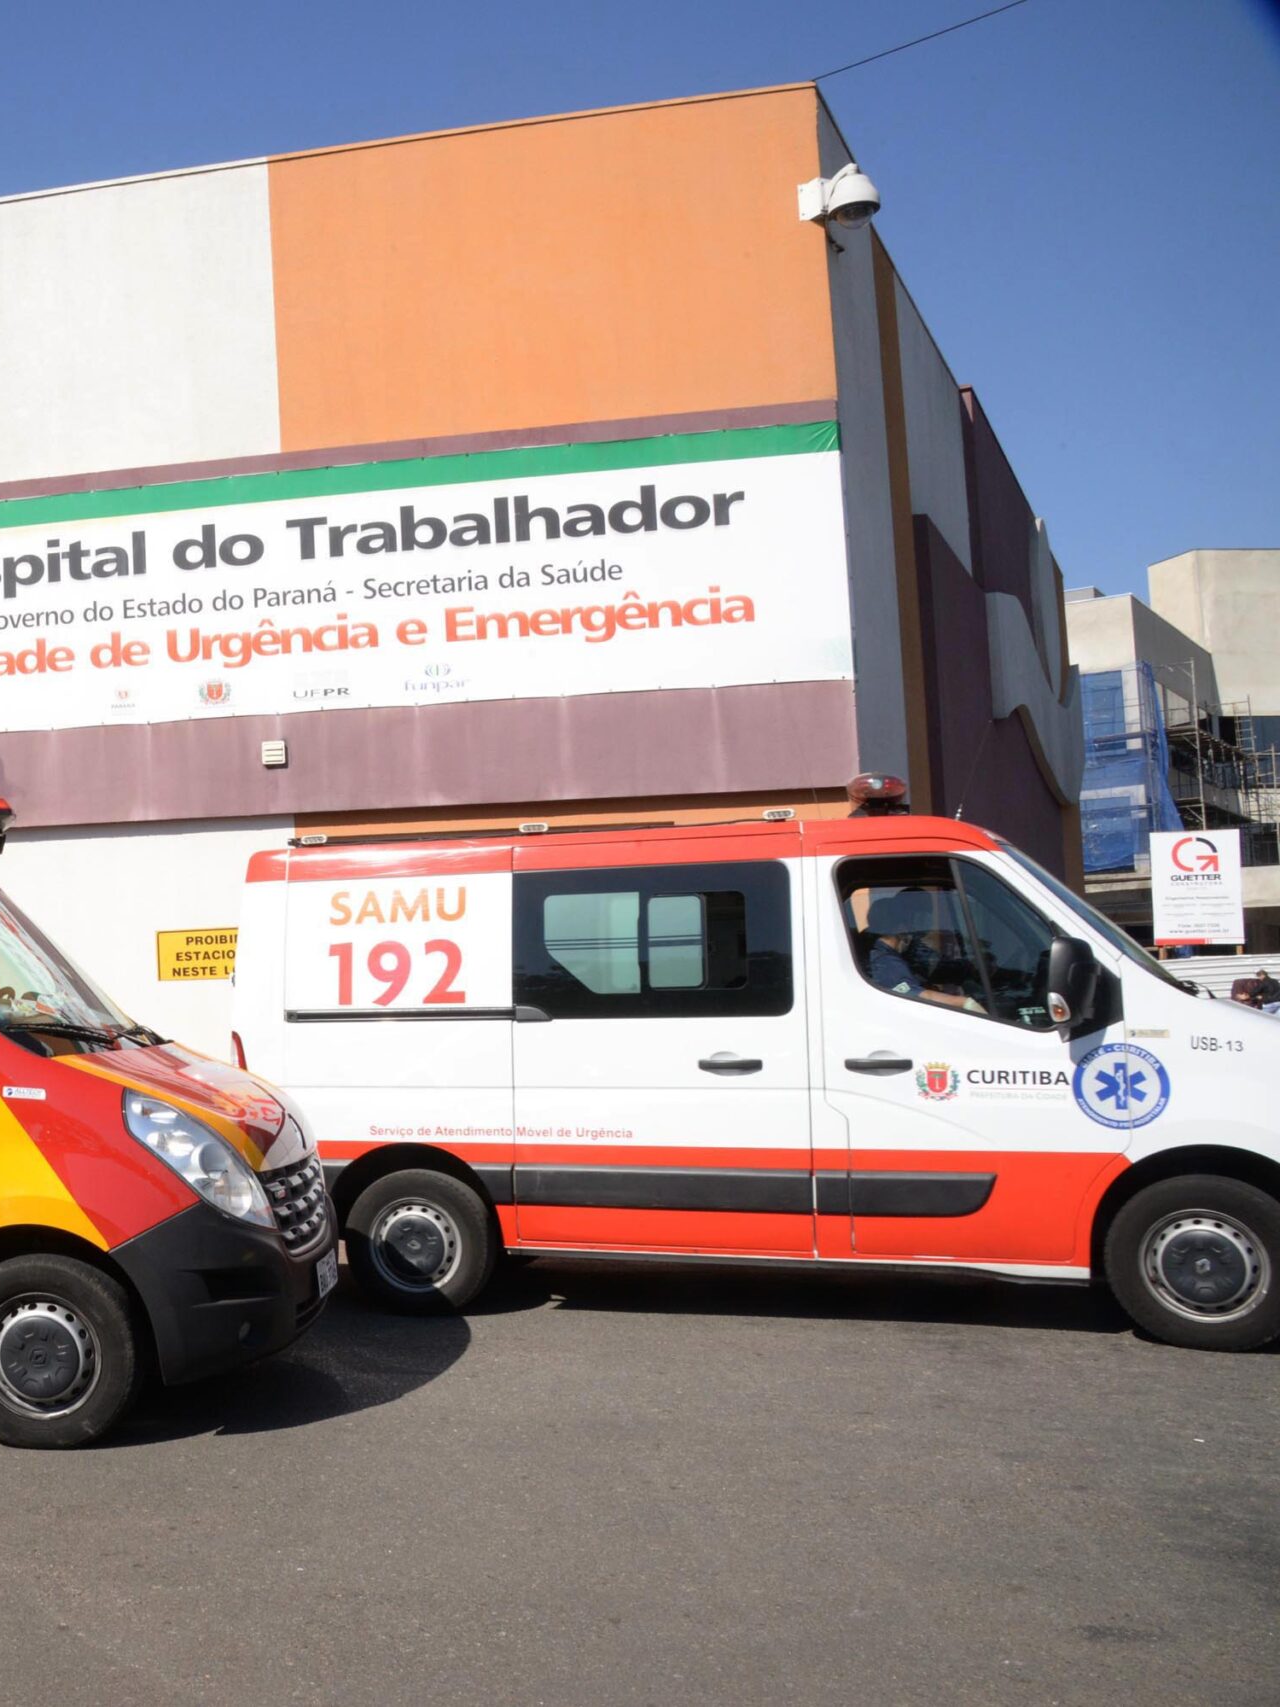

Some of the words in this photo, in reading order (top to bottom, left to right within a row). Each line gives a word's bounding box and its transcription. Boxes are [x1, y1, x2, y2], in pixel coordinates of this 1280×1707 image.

[172, 524, 265, 571] do
[286, 484, 745, 561] Trabalhador
[82, 601, 114, 623] do
[123, 593, 203, 619] Estado
[212, 589, 244, 611] do
[252, 581, 337, 608] Paraná
[363, 569, 488, 600] Secretaria
[498, 565, 531, 588] da
[540, 560, 623, 586] Saúde
[90, 632, 150, 669] de
[166, 612, 378, 667] Urgência
[397, 615, 427, 646] e
[445, 585, 755, 643] Emergência
[293, 687, 350, 699] UFPR
[330, 887, 467, 926] SAMU
[172, 966, 217, 977] NESTE
[328, 939, 466, 1006] 192
[967, 1070, 1070, 1086] CURITIBA
[369, 1126, 413, 1138] Serviço
[417, 1126, 431, 1136] de
[435, 1127, 512, 1137] Atendimento
[516, 1127, 552, 1138] Móvel
[557, 1127, 572, 1138] de
[576, 1127, 633, 1140] Urgência
